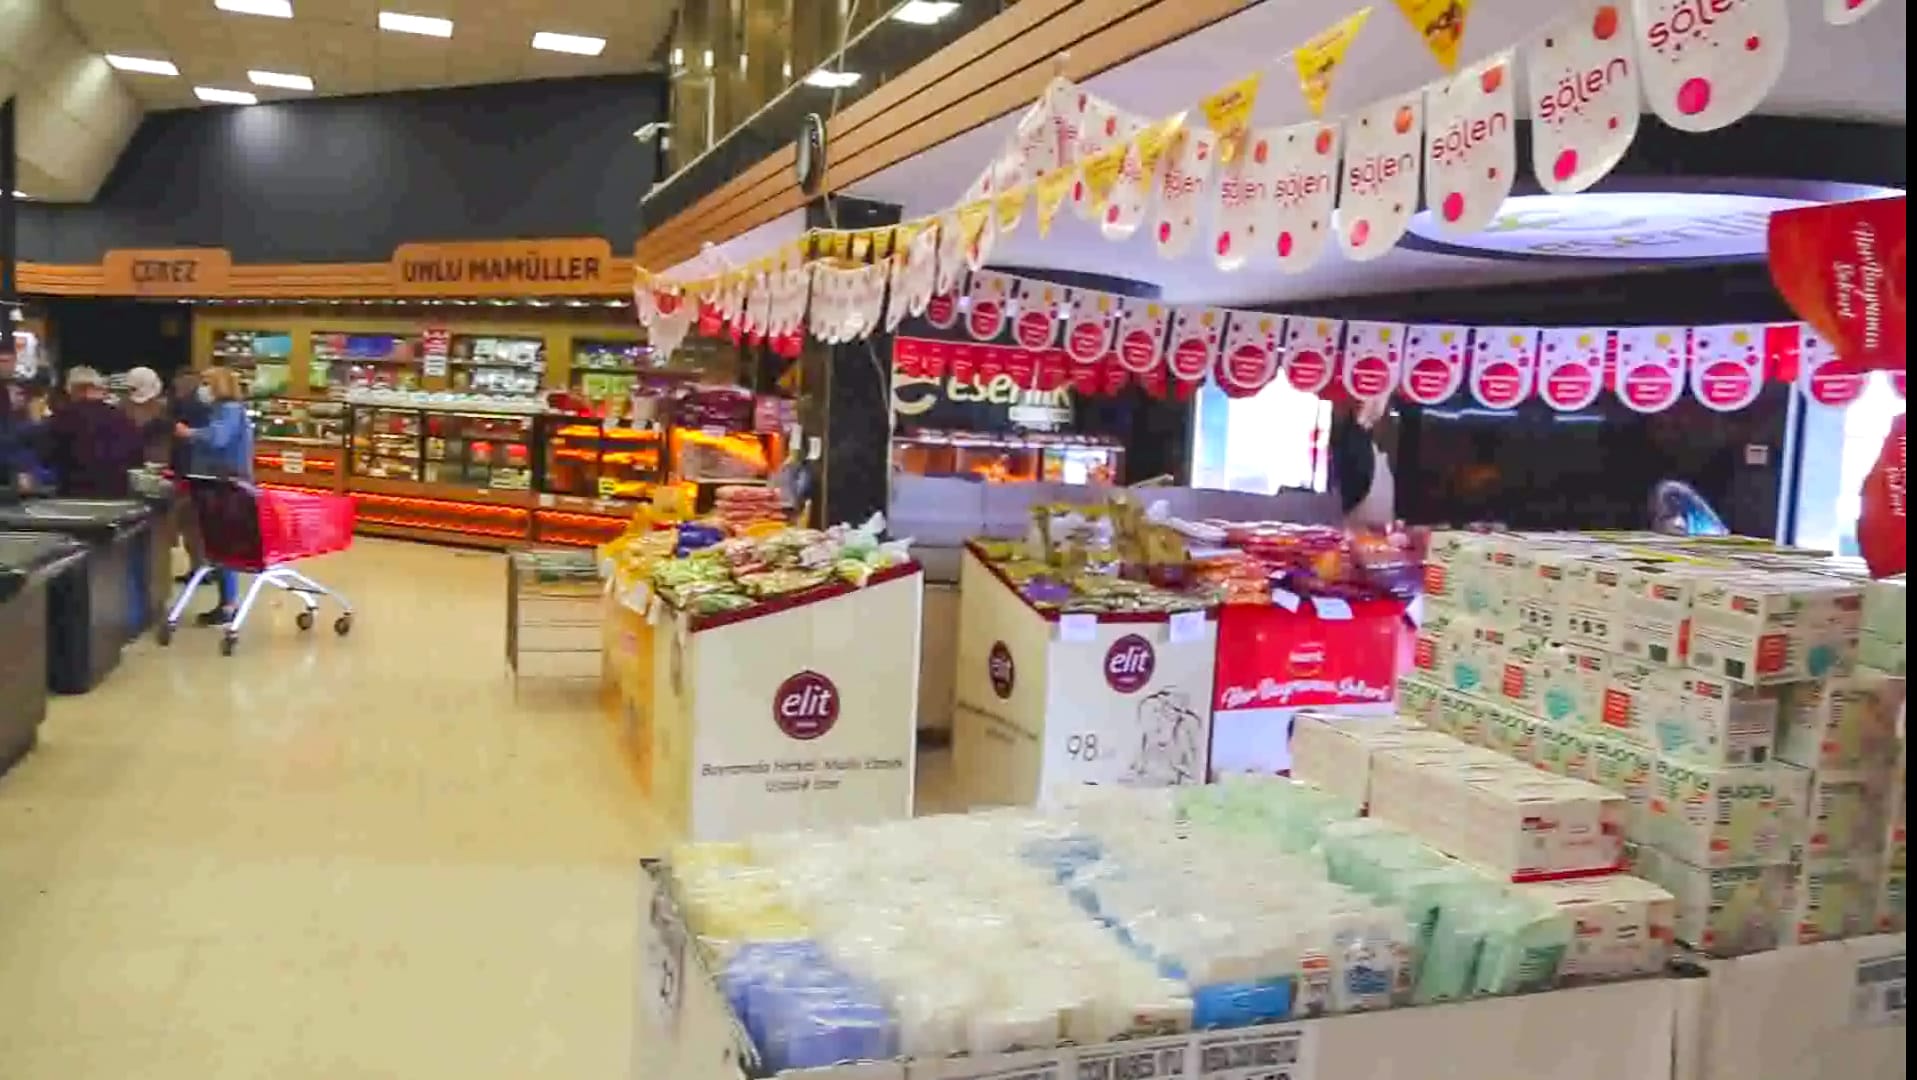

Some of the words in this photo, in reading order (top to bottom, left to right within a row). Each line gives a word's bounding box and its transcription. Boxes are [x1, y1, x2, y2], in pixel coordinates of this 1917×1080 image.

[468, 250, 600, 282] MAMÜLLER
[1110, 646, 1149, 674] elit
[781, 684, 832, 717] elit
[1067, 733, 1099, 761] 98
